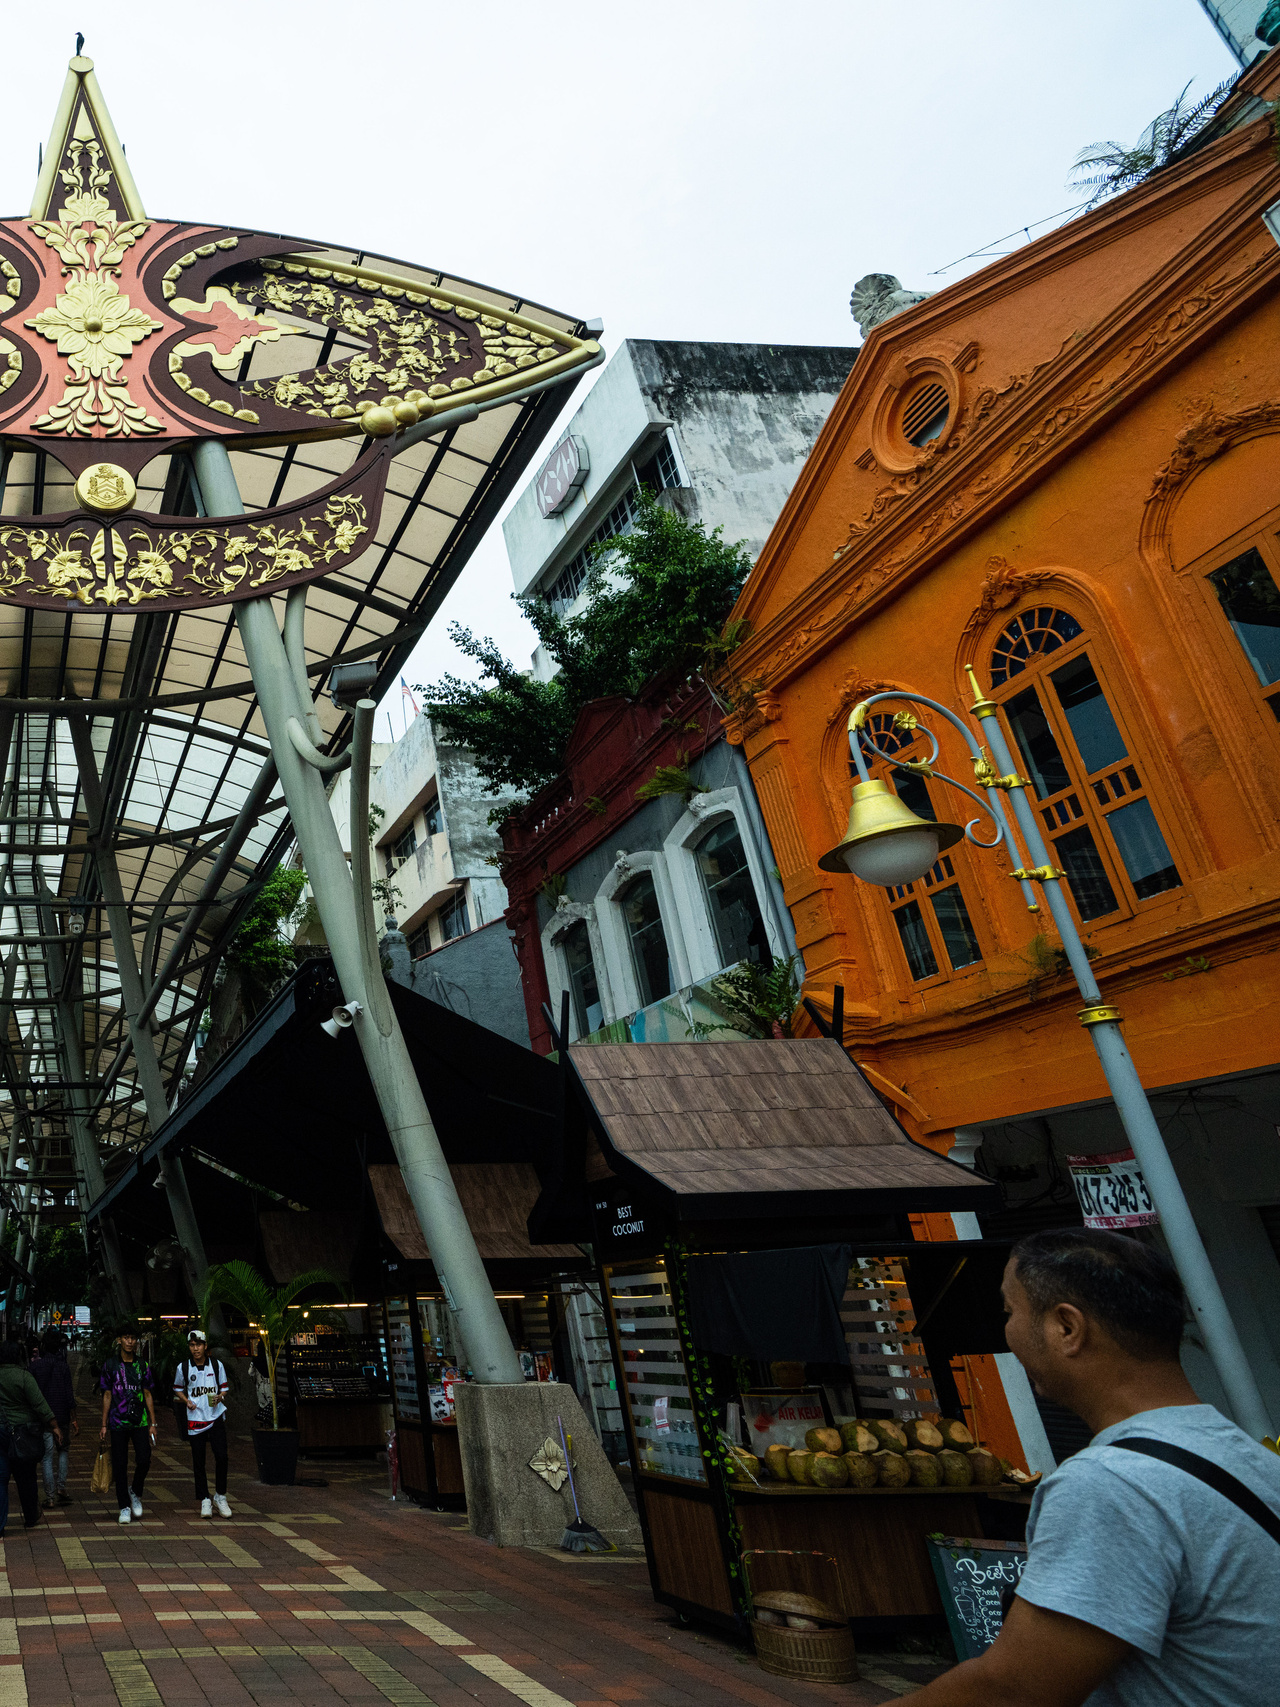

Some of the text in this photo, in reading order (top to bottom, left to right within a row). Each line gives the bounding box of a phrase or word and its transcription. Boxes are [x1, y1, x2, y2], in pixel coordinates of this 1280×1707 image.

[617, 1205, 632, 1219] BEST
[612, 1220, 645, 1236] COCONUT
[778, 1407, 795, 1420] AIR
[955, 1557, 1015, 1584] Best
[971, 1584, 1000, 1599] Fresh
